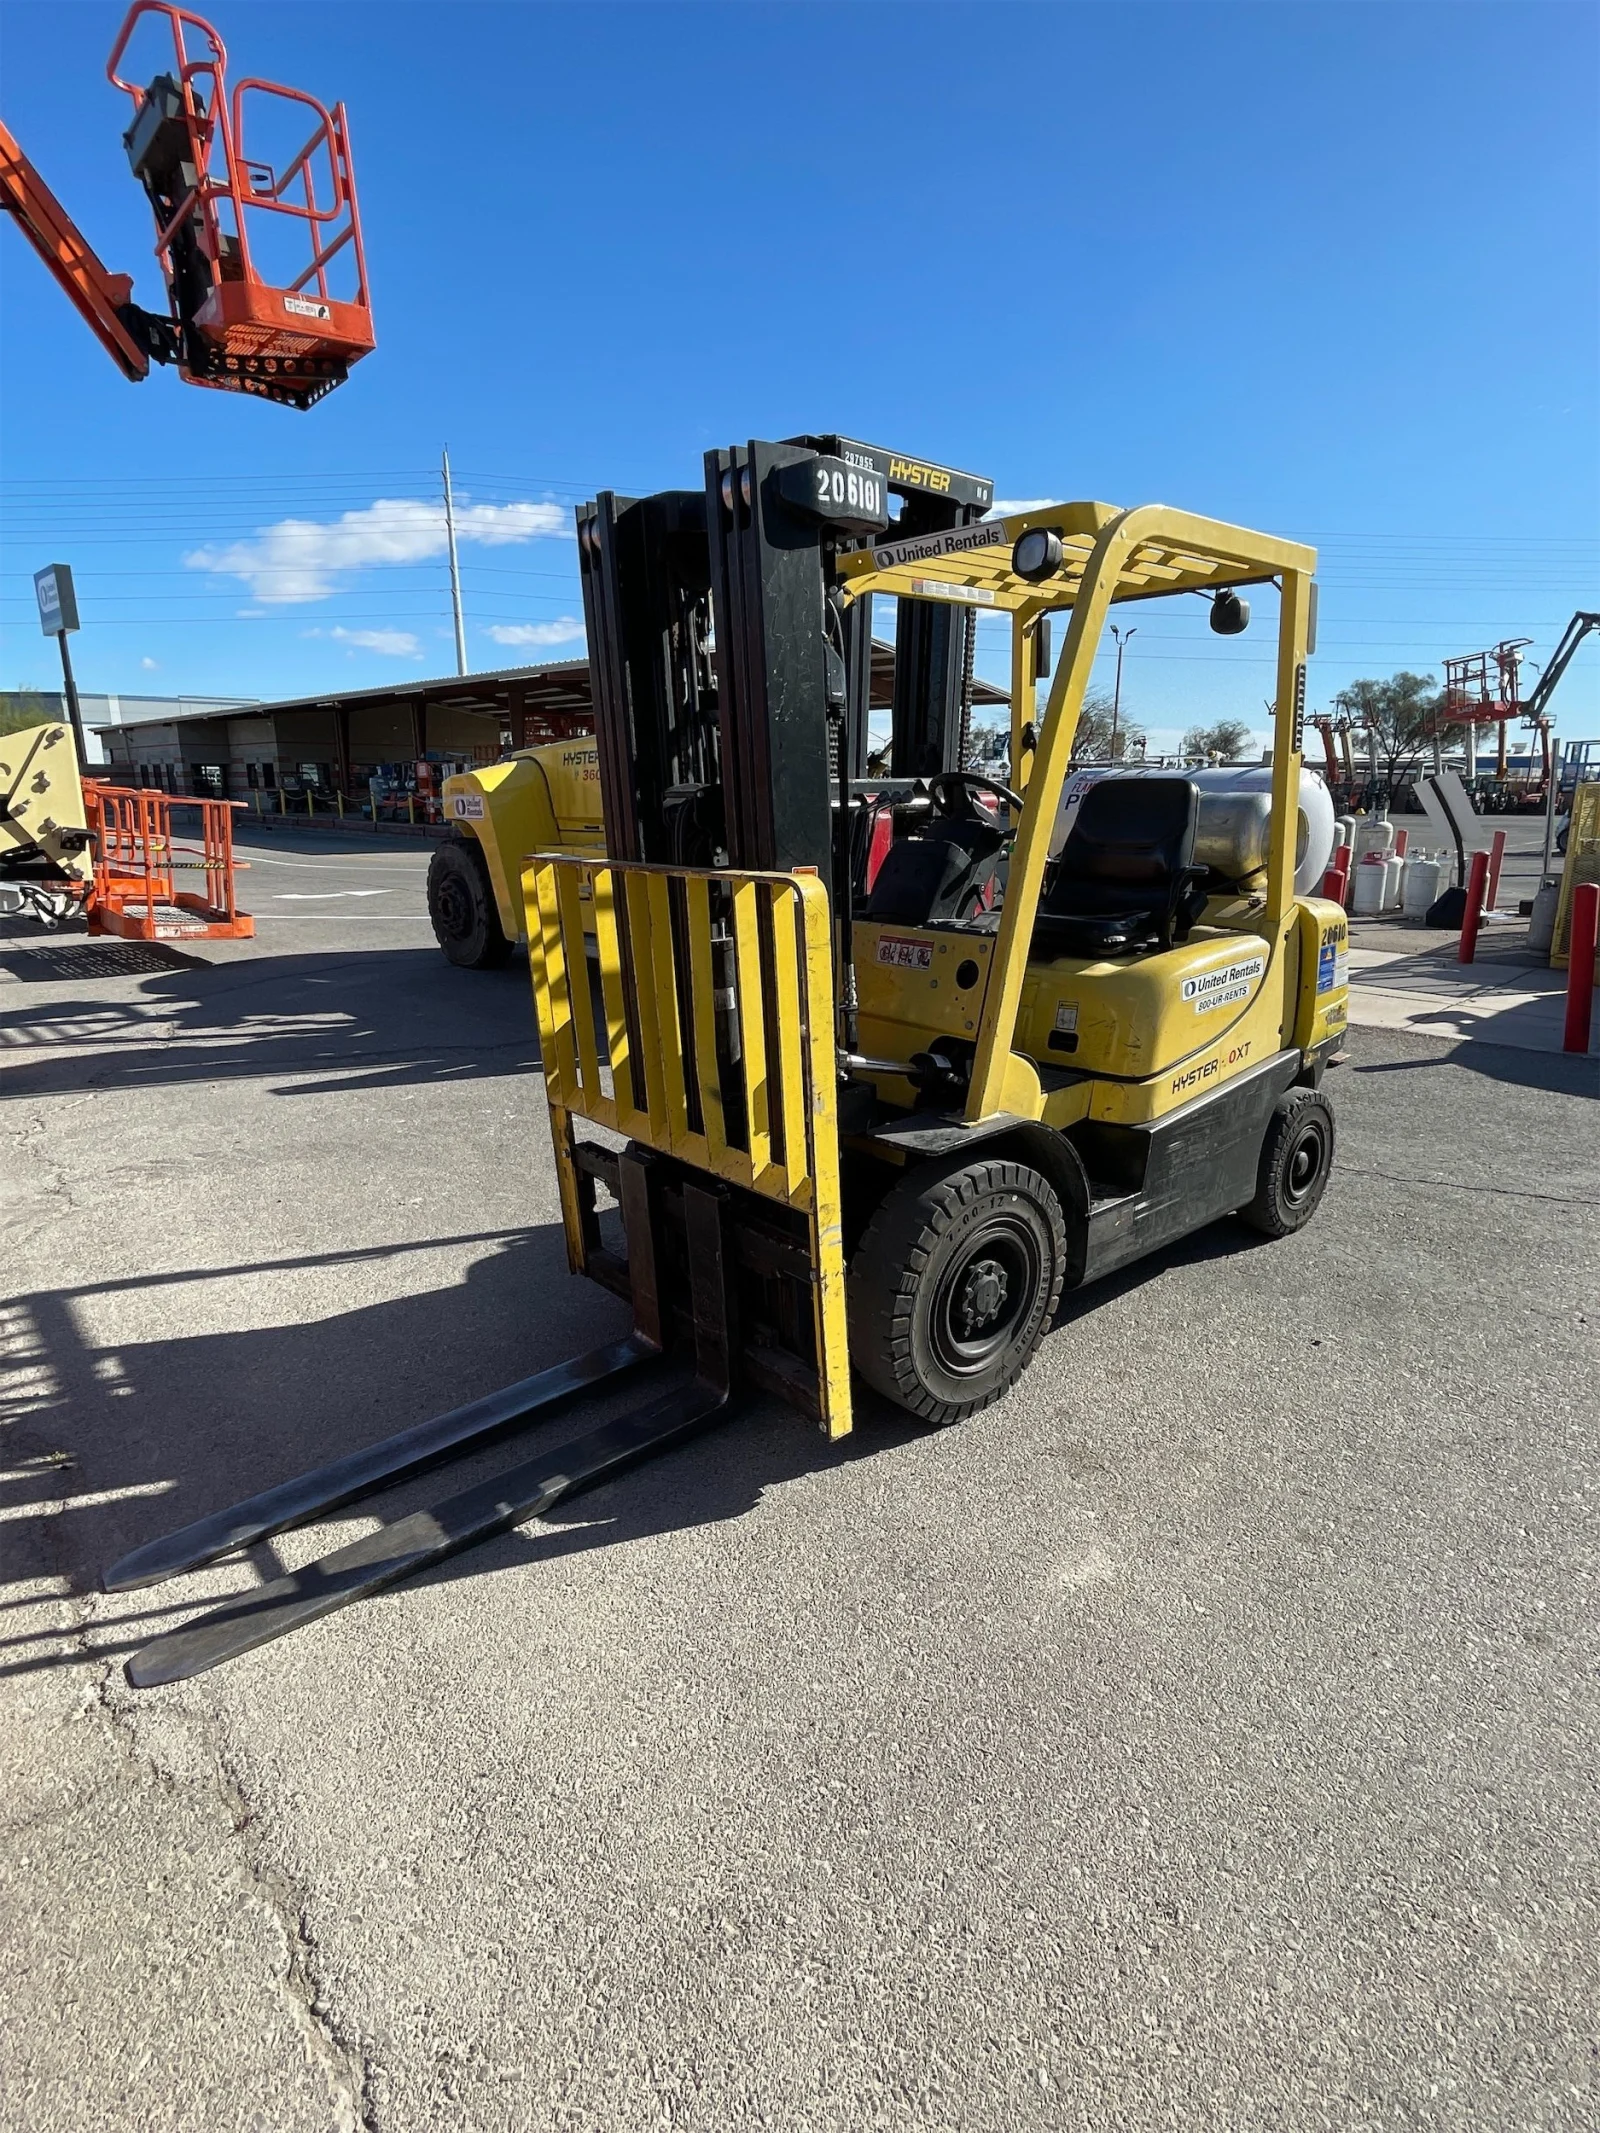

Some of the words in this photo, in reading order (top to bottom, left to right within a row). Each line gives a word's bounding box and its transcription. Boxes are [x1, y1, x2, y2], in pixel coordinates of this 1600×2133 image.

[817, 469, 880, 515] 206101
[889, 458, 950, 492] HYSTER
[896, 540, 941, 563] United
[945, 528, 999, 553] Rentals
[1197, 970, 1228, 993] United
[1229, 961, 1261, 982] Rentals
[1198, 985, 1248, 1012] 800-UR-RENTS
[1172, 1058, 1218, 1094] HYSTER
